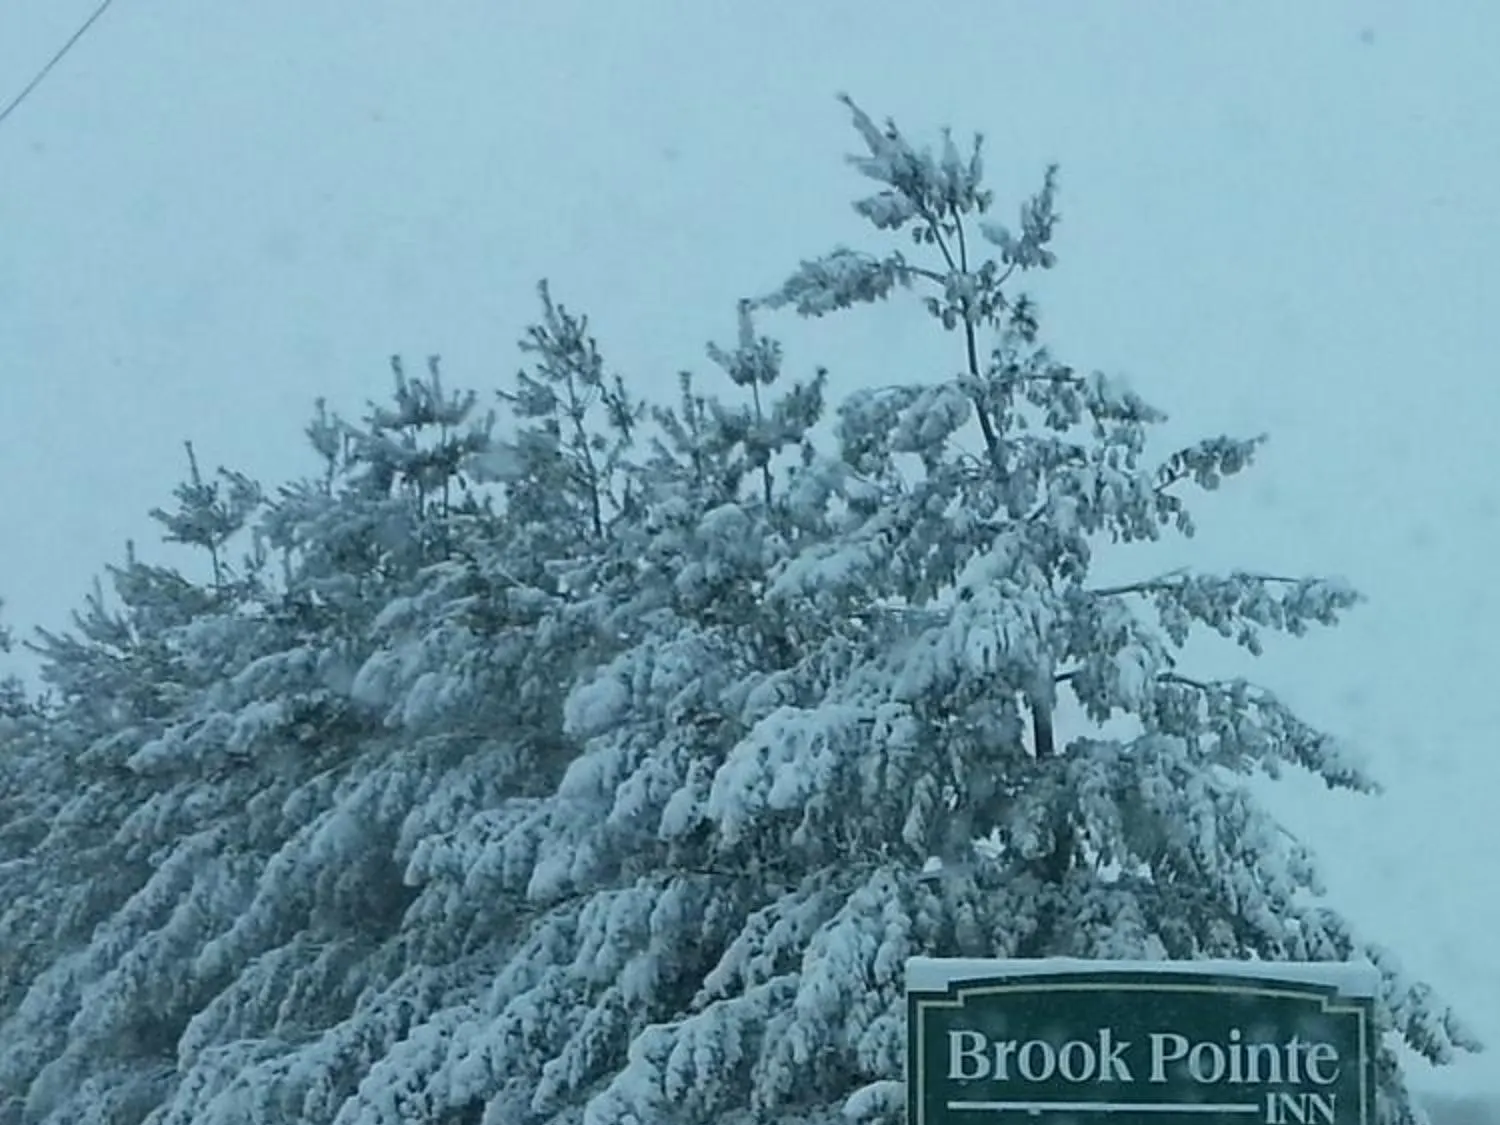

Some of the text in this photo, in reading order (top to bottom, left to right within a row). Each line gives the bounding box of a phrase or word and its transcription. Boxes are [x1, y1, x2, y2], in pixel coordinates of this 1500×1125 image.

[947, 1028, 1341, 1084] Brook Pointe
[1266, 1093, 1336, 1125] INN
